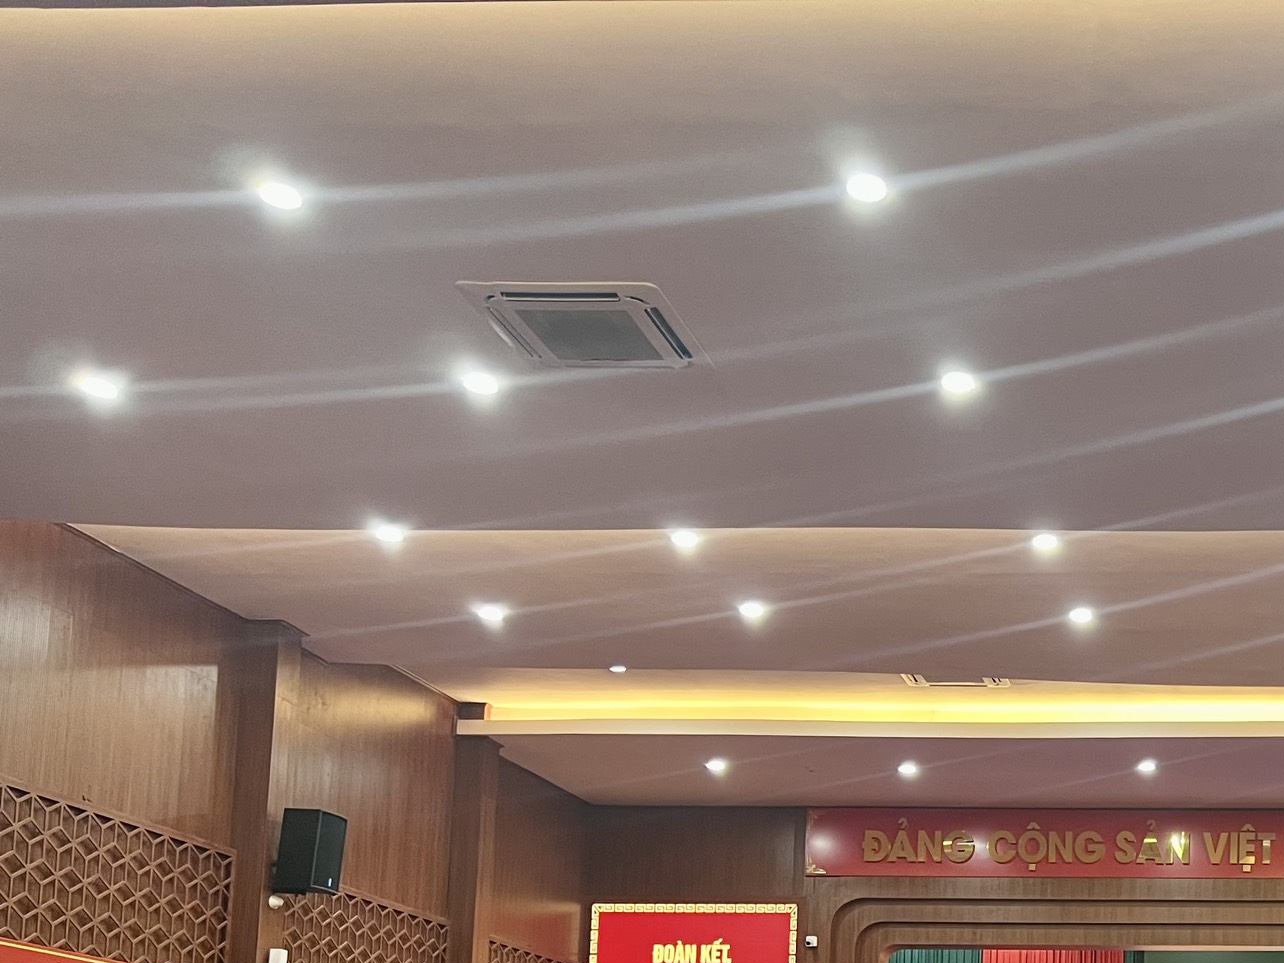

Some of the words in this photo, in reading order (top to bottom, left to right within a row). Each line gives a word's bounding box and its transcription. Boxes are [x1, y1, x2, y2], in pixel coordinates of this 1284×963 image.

[862, 818, 975, 864] ĐẢNG
[987, 822, 1104, 872] CỘNG
[1115, 820, 1192, 865] SẢN
[1203, 824, 1275, 872] VIỆT
